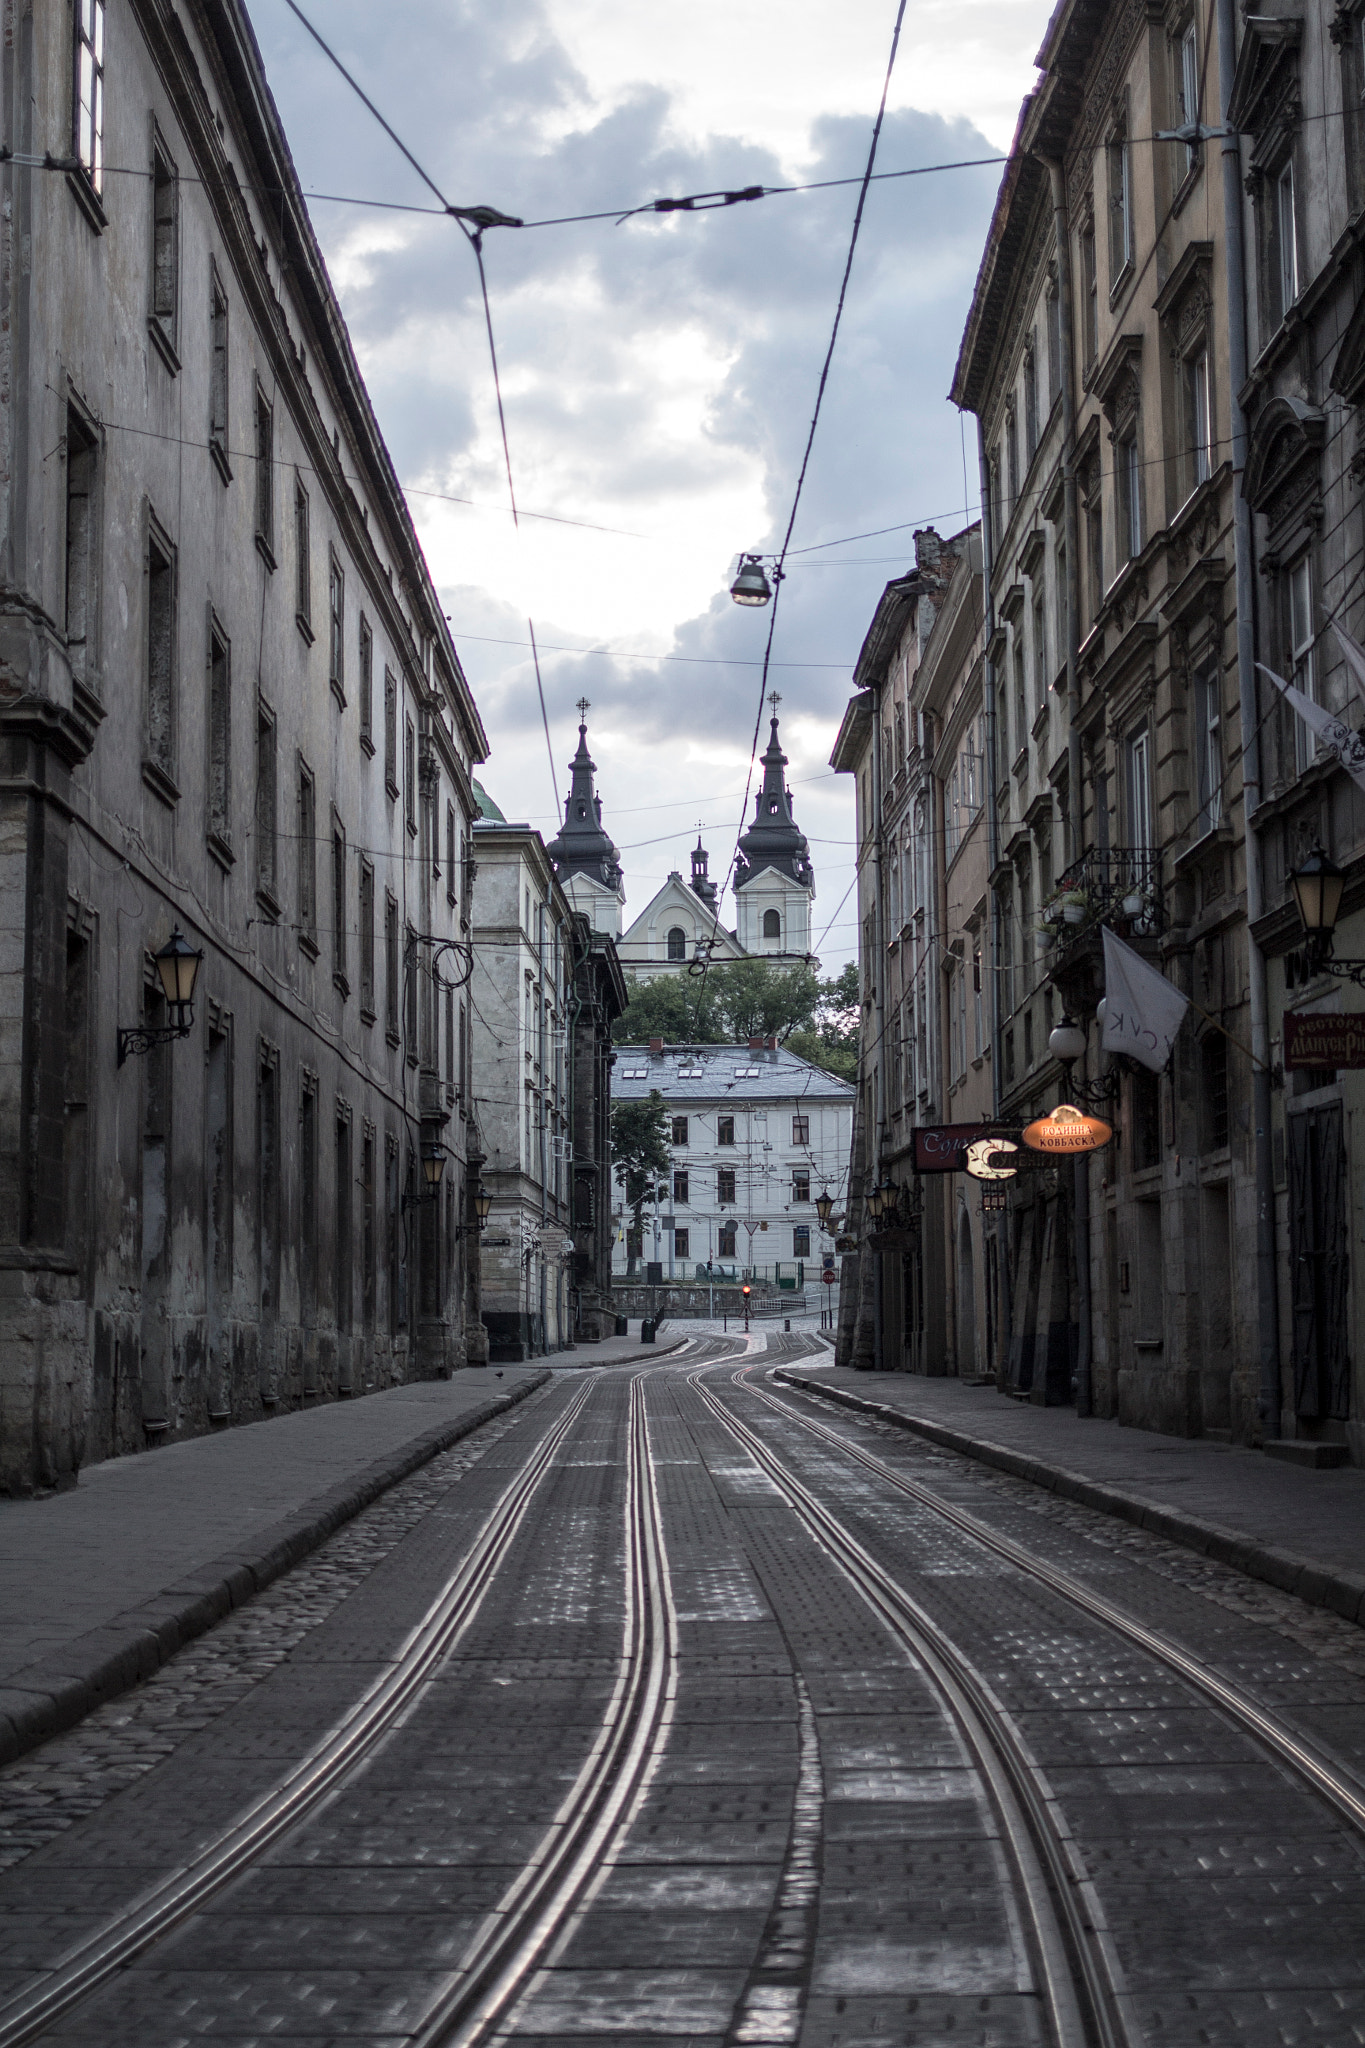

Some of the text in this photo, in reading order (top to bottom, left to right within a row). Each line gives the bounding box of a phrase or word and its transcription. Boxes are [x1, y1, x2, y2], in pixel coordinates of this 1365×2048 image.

[1297, 1017, 1365, 1036] РЕСТОРА
[1042, 1125, 1093, 1136] РОДИННА
[1039, 1137, 1096, 1147] КОВБАСКА
